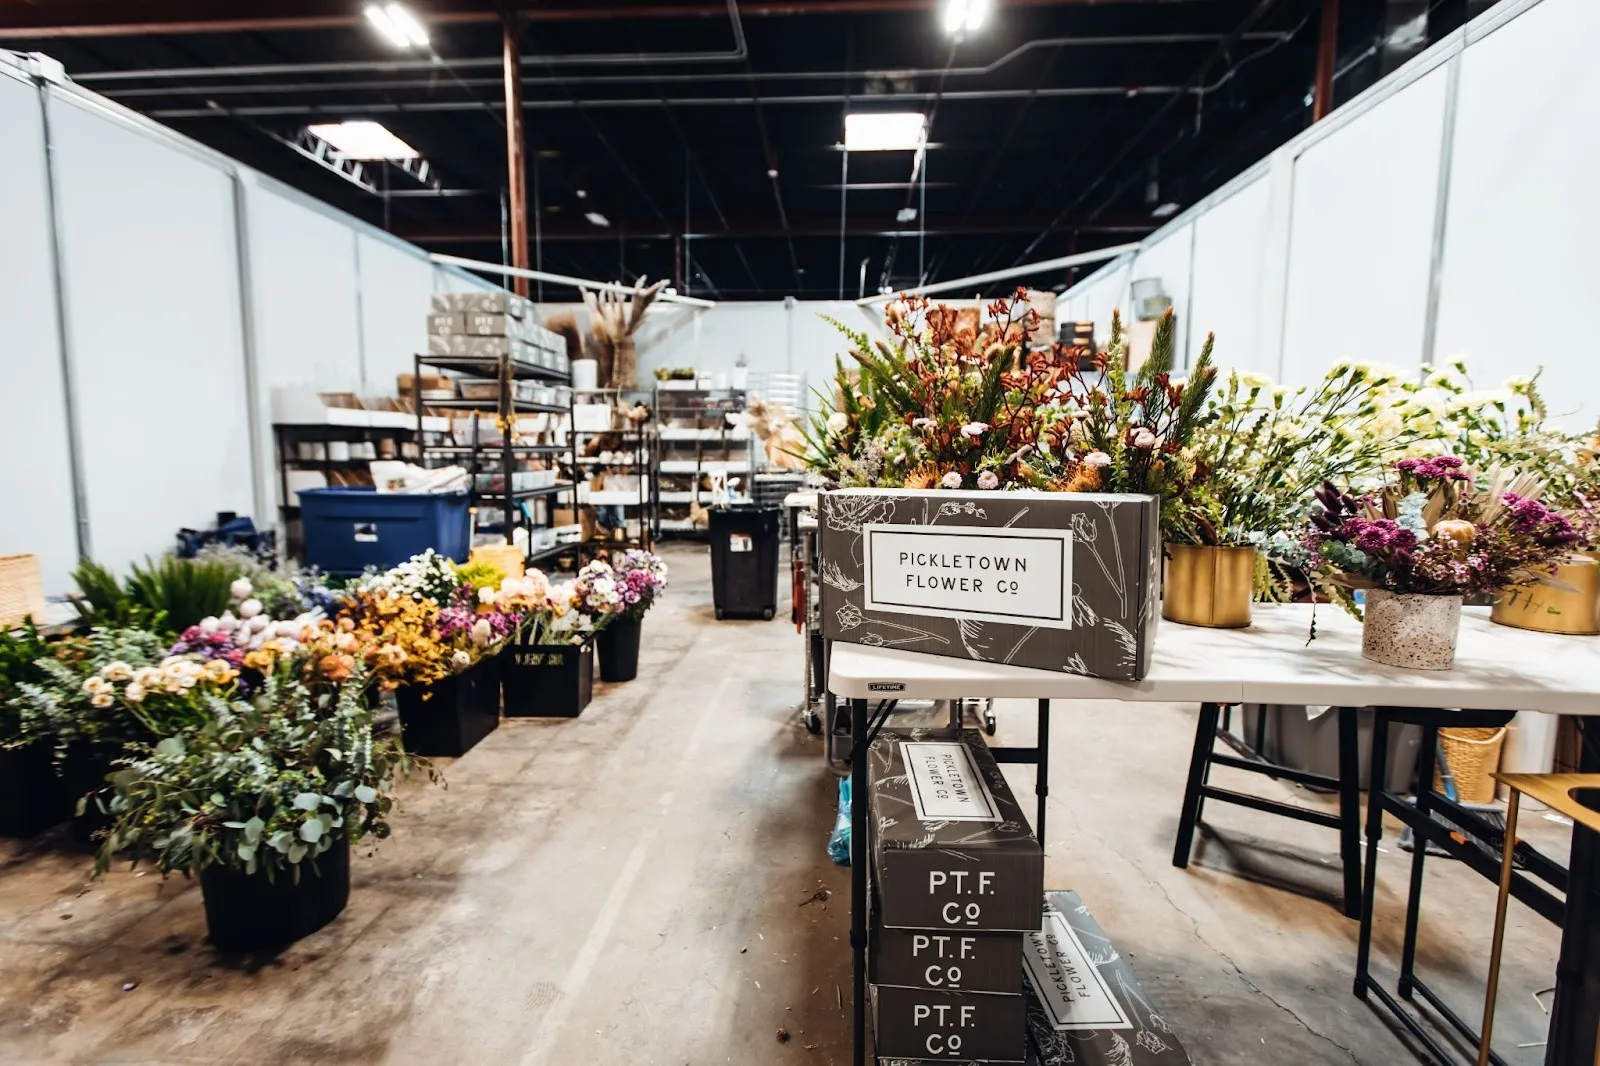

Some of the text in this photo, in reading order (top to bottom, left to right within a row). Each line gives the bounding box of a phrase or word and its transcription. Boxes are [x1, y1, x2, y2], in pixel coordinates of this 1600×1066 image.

[899, 551, 1028, 573] PICKLETOWN
[905, 574, 984, 593] FLOWER
[925, 756, 944, 786] FLOWER
[941, 753, 971, 803] PICKLETOWN
[1056, 951, 1091, 998] FLOWER
